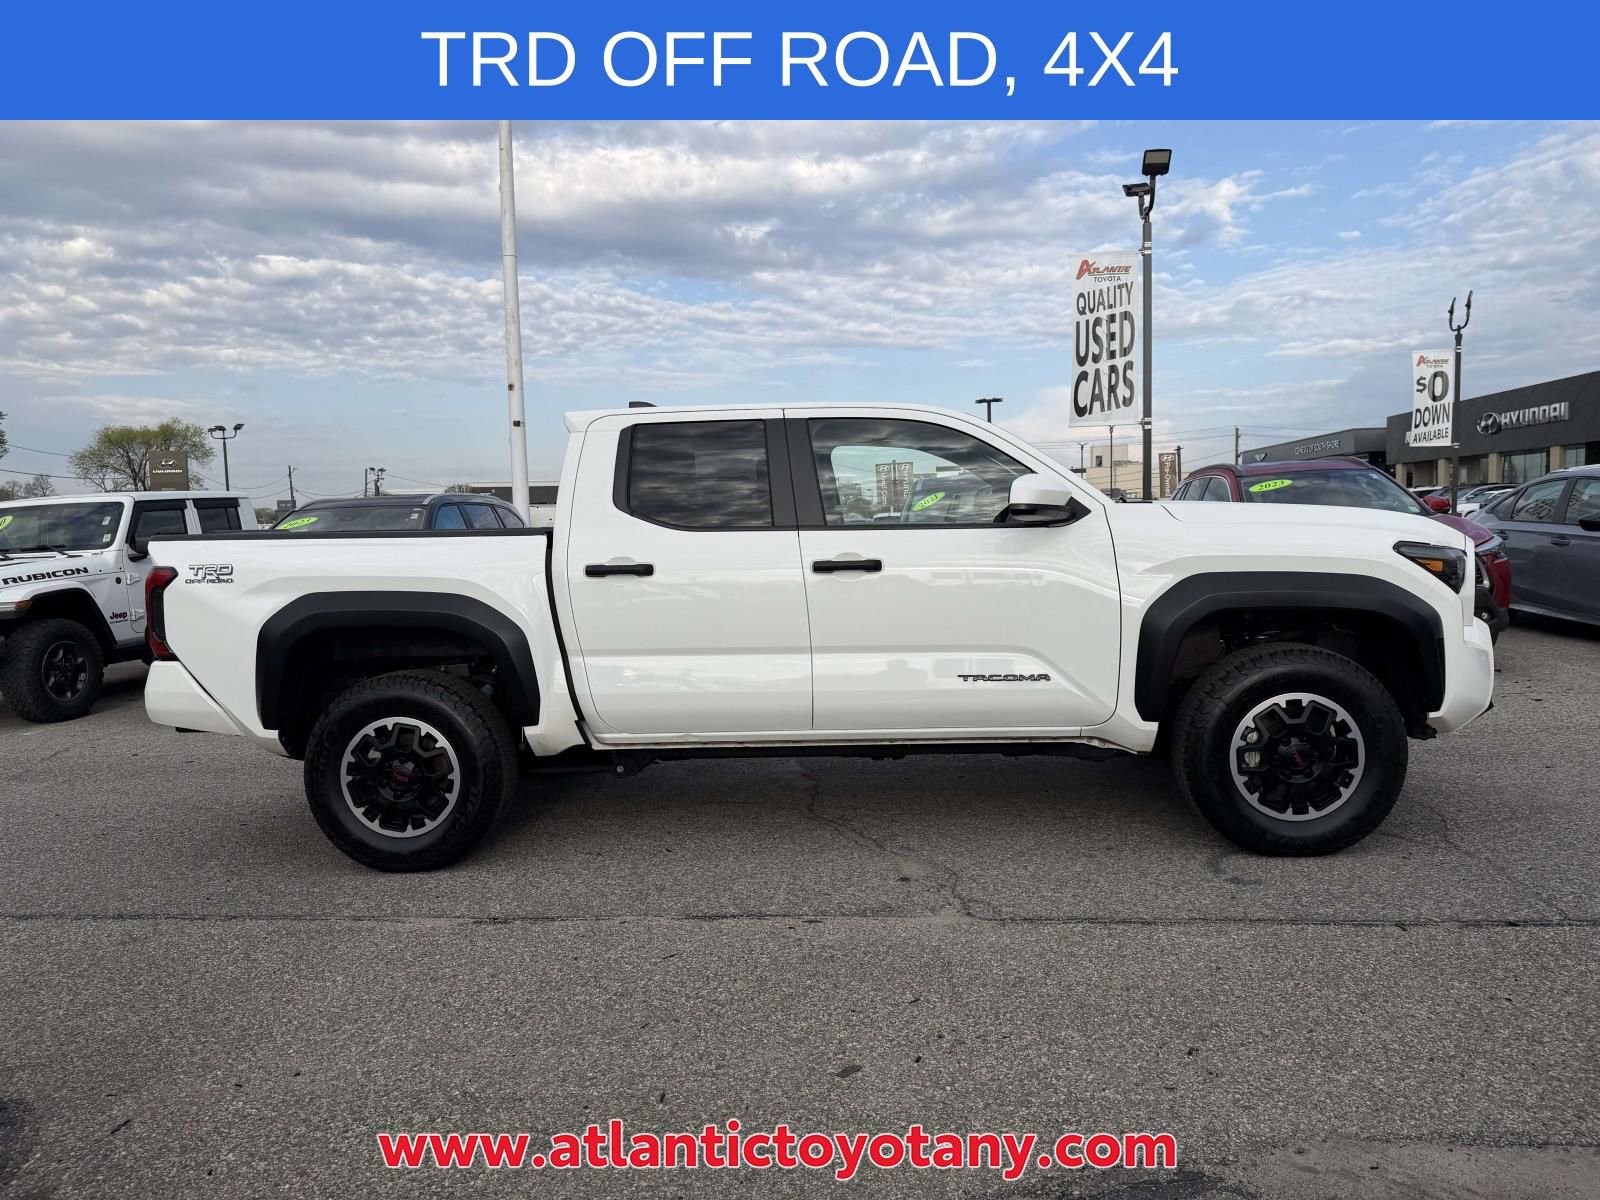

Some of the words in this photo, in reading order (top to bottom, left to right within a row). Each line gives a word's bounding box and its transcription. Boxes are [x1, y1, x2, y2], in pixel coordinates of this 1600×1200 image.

[1076, 281, 1133, 316] QUALITY
[1076, 310, 1135, 367] USED
[1073, 360, 1135, 418] CARS
[1416, 370, 1449, 402] $0
[1414, 402, 1450, 429] DOWN
[1501, 401, 1568, 428] HYUNDAI
[1413, 427, 1448, 444] AVAILABLE
[1, 566, 89, 586] RUBICON
[188, 564, 234, 580] TRD
[109, 611, 128, 620] Jeep
[957, 673, 1051, 682] TACOMA
